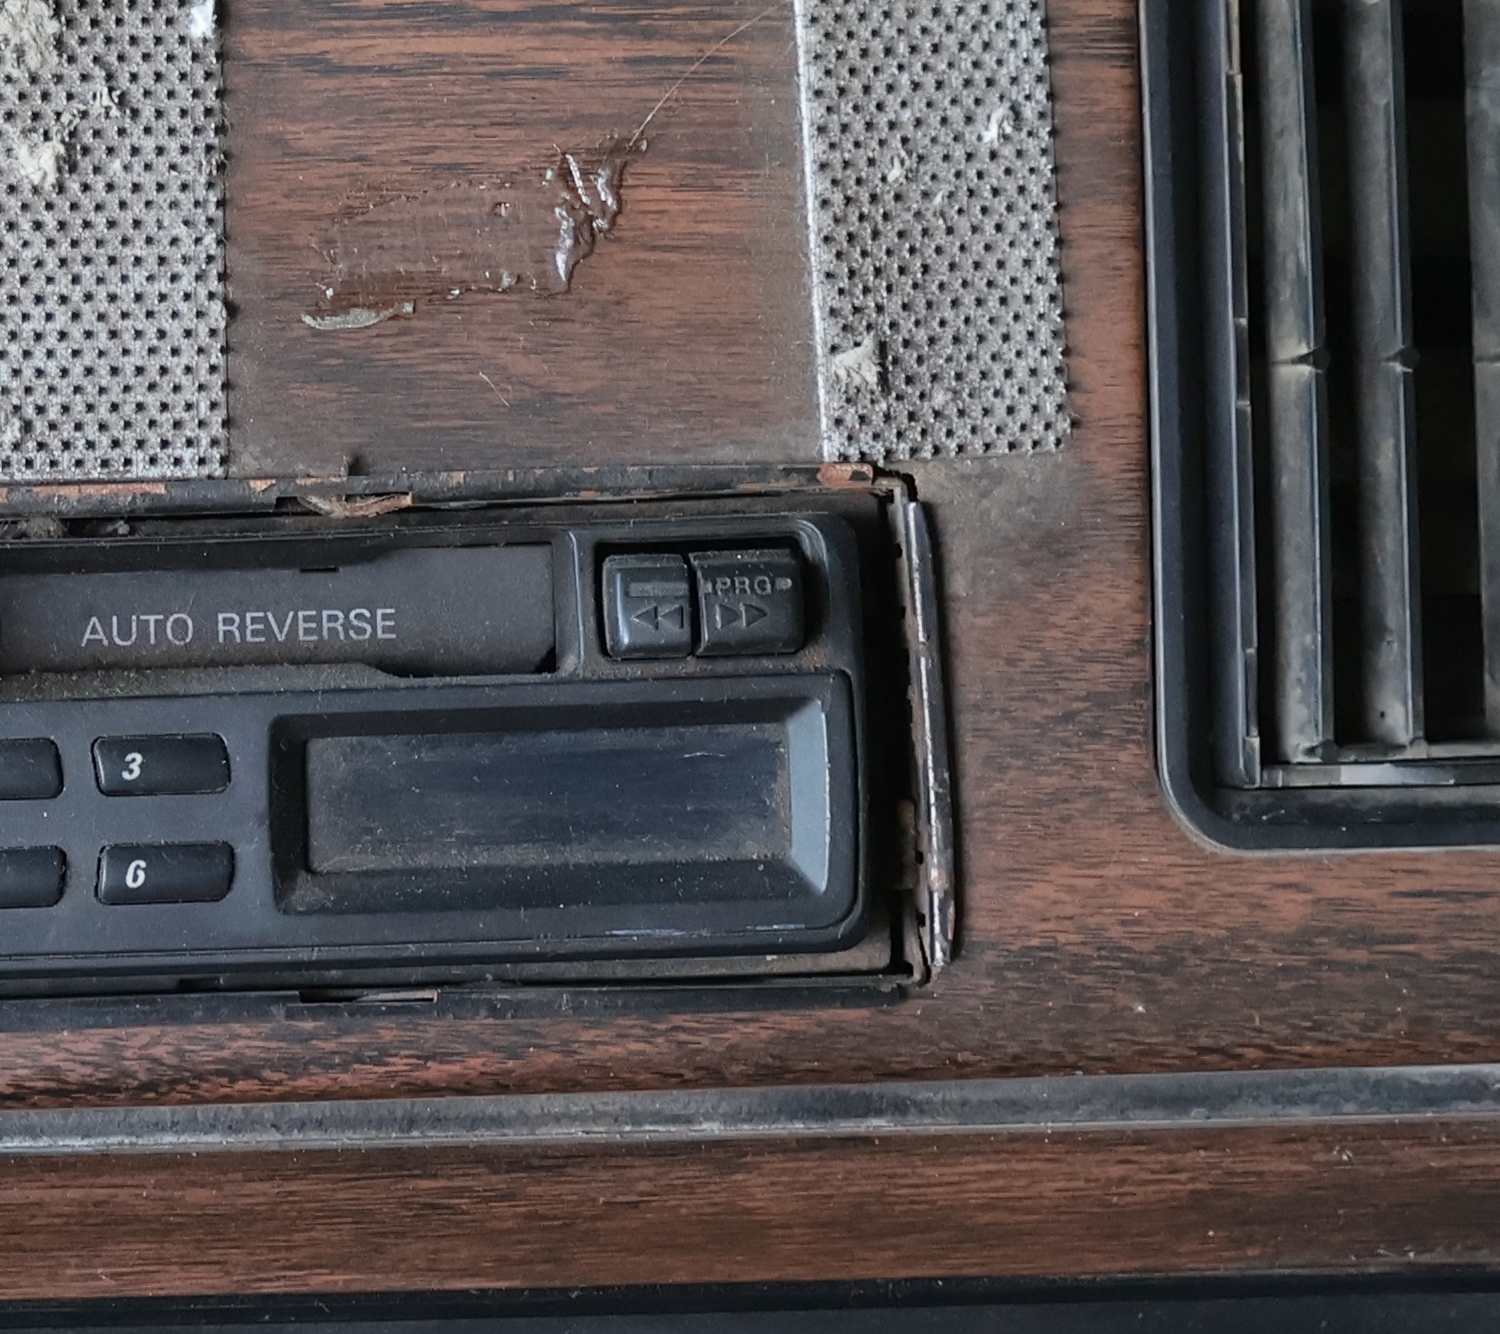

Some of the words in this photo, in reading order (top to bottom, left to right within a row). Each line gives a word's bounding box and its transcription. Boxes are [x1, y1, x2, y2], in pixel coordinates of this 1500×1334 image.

[715, 575, 772, 596] PRG
[80, 613, 193, 648] AUTO
[217, 607, 397, 644] REVERSE
[121, 751, 143, 782] 3
[125, 859, 146, 888] 6
